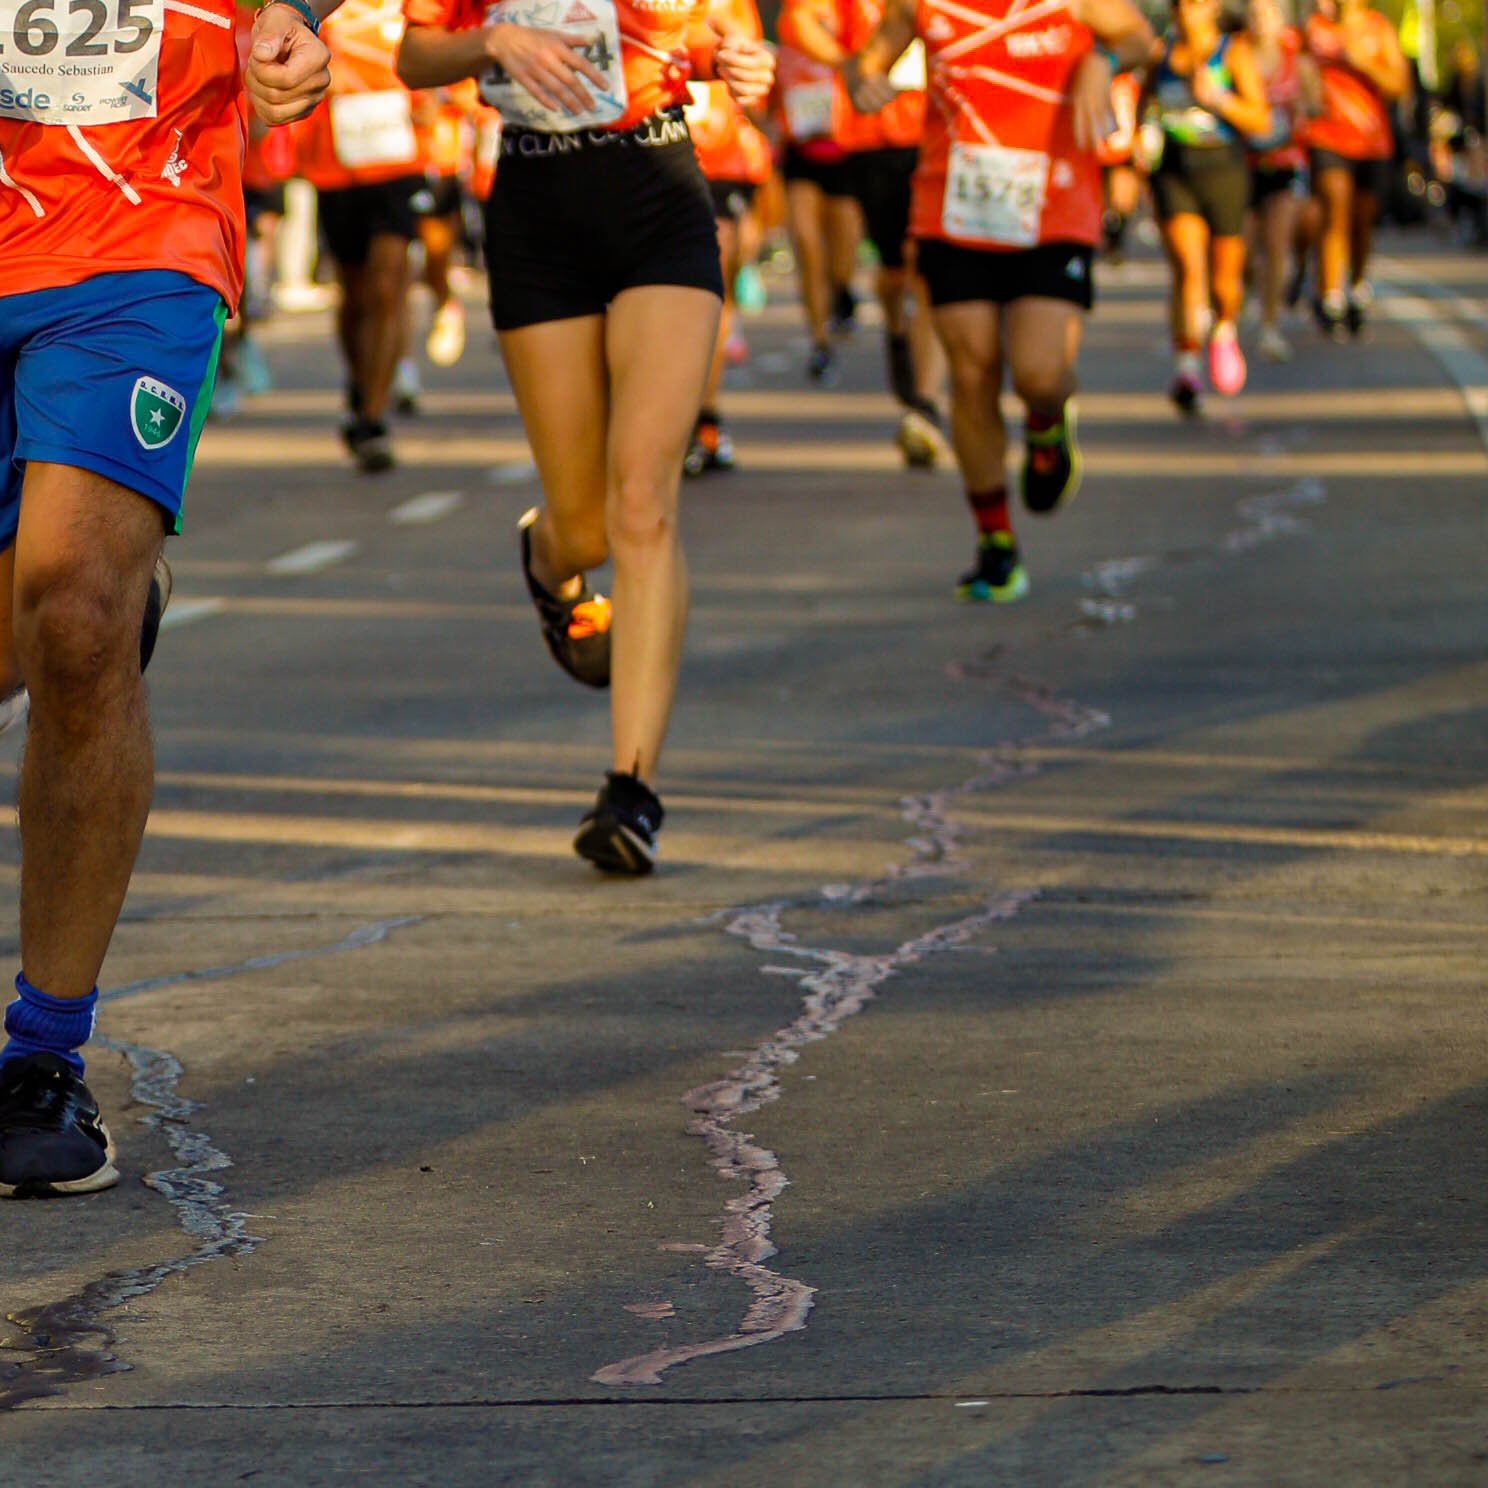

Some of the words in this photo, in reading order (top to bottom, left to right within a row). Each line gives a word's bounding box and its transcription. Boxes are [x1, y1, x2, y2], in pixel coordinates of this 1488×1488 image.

[2, 63, 54, 76] Saucedo
[57, 63, 114, 76] Sebastian
[520, 133, 583, 155] CLAN
